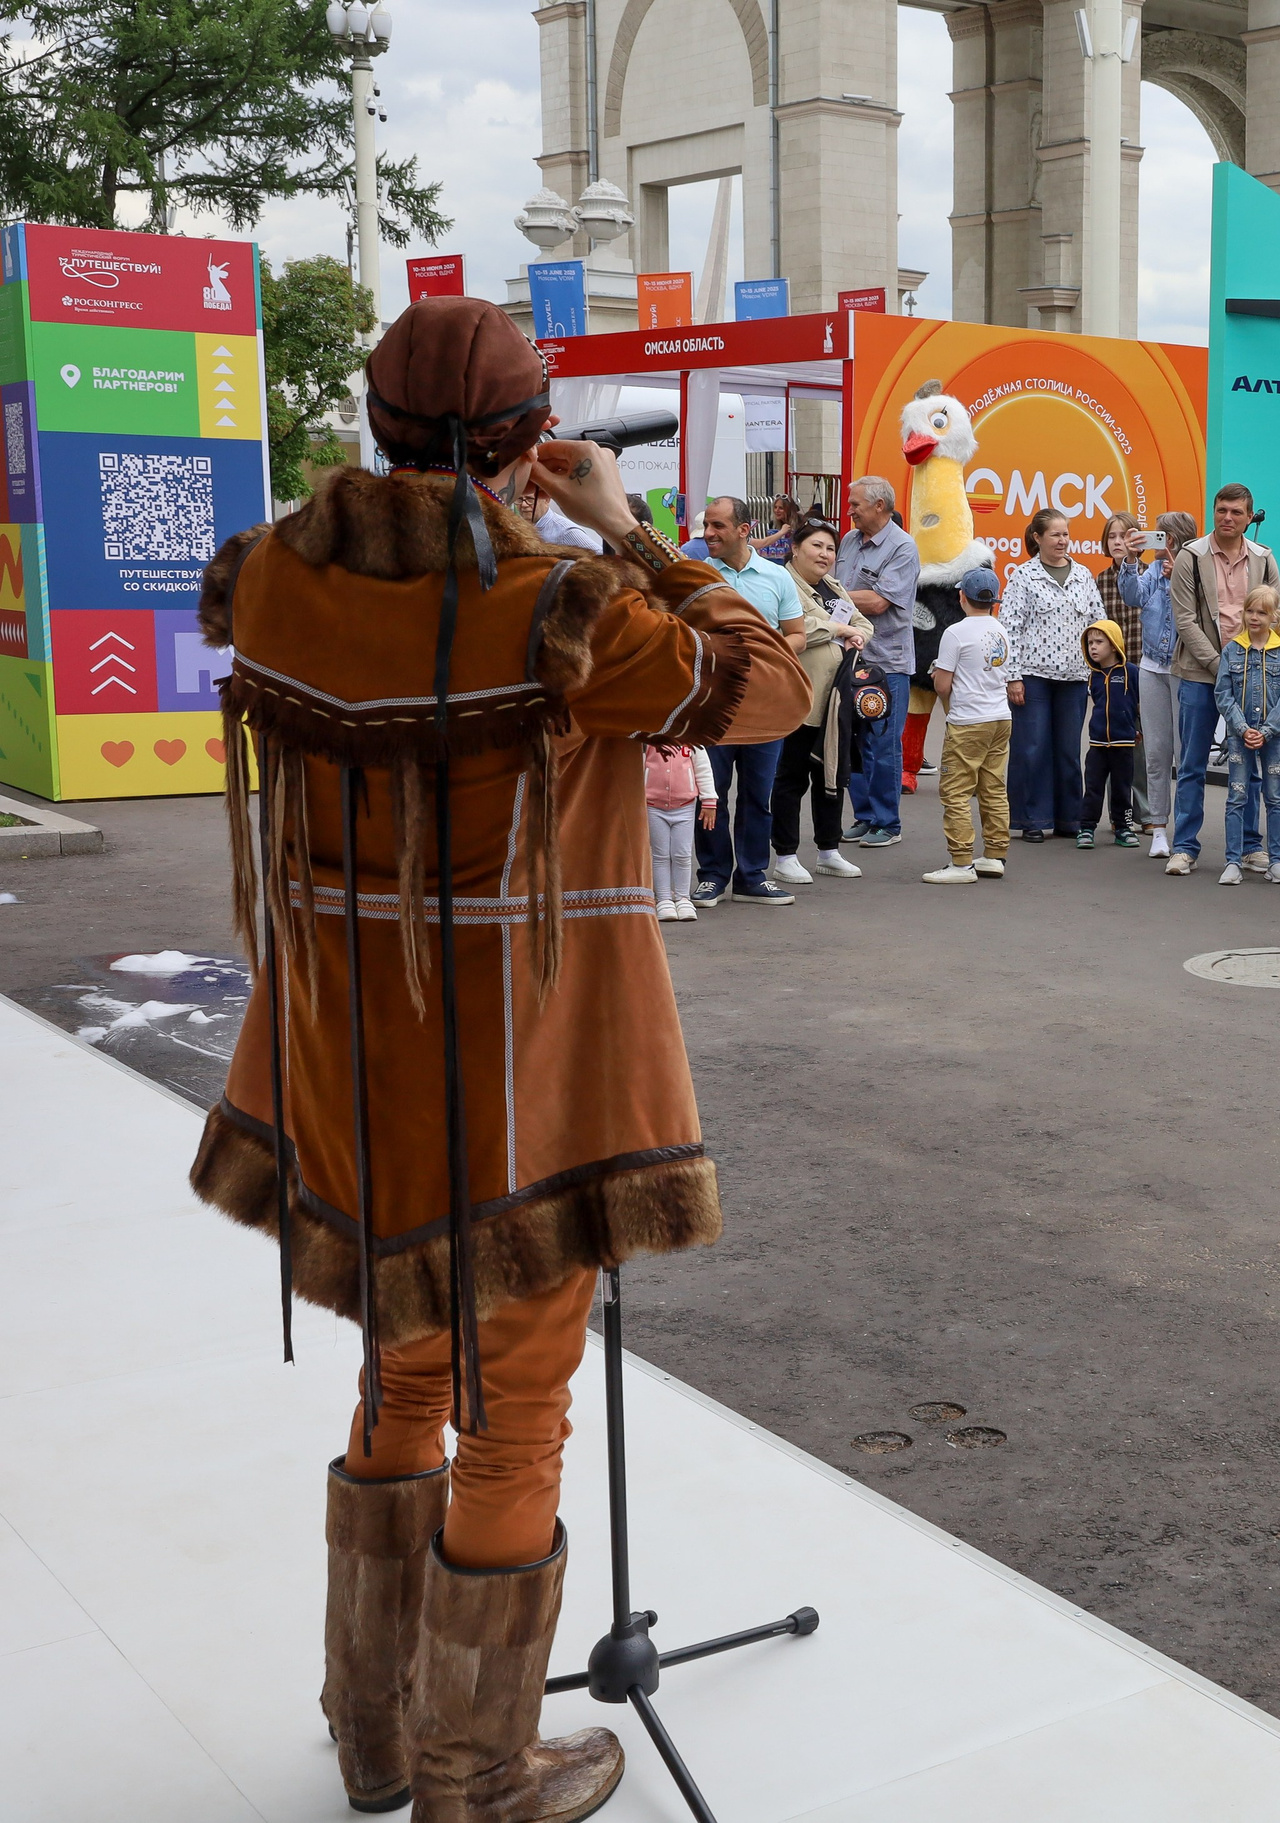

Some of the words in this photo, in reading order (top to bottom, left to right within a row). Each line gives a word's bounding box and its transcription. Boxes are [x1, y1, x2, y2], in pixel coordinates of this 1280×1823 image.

[71, 258, 162, 275] ПУТЕШЕСТВУЙ!
[74, 297, 143, 310] РОСКОНГРЕСС
[544, 299, 553, 334] TRAVEL!
[644, 339, 682, 356] ОМСКАЯ
[682, 336, 725, 353] ОБЛАСТЬ
[92, 366, 185, 382] БЛАГОДАРИМ
[93, 379, 178, 393] ПАРТНЕРОВ!
[1024, 378, 1073, 397] СТОЛИЦА
[965, 467, 1113, 520] ОМСК
[123, 582, 140, 591] СО
[142, 580, 202, 593] СКИДКОЙ!
